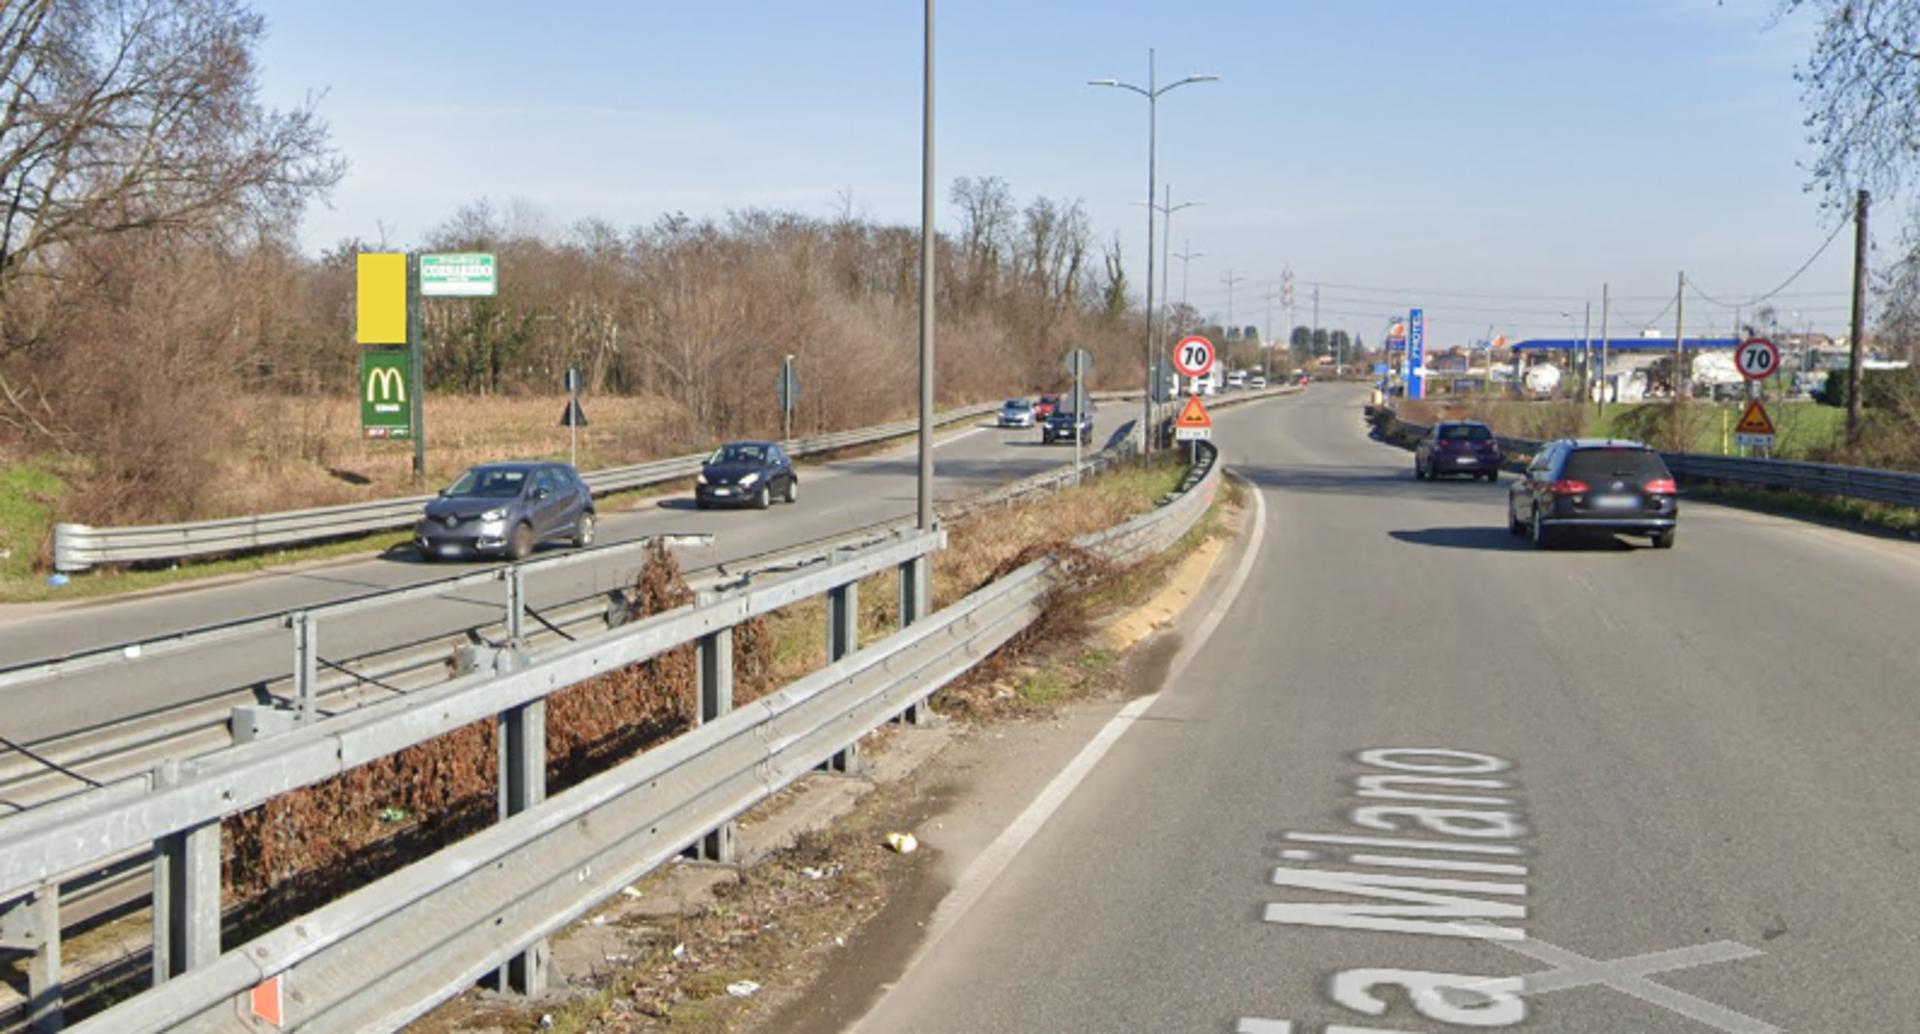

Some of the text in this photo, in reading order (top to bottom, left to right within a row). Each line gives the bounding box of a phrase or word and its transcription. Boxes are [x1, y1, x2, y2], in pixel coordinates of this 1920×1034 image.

[1184, 347, 1206, 366] 70
[1746, 349, 1771, 369] 70
[1237, 747, 1528, 1034] ia Milano
